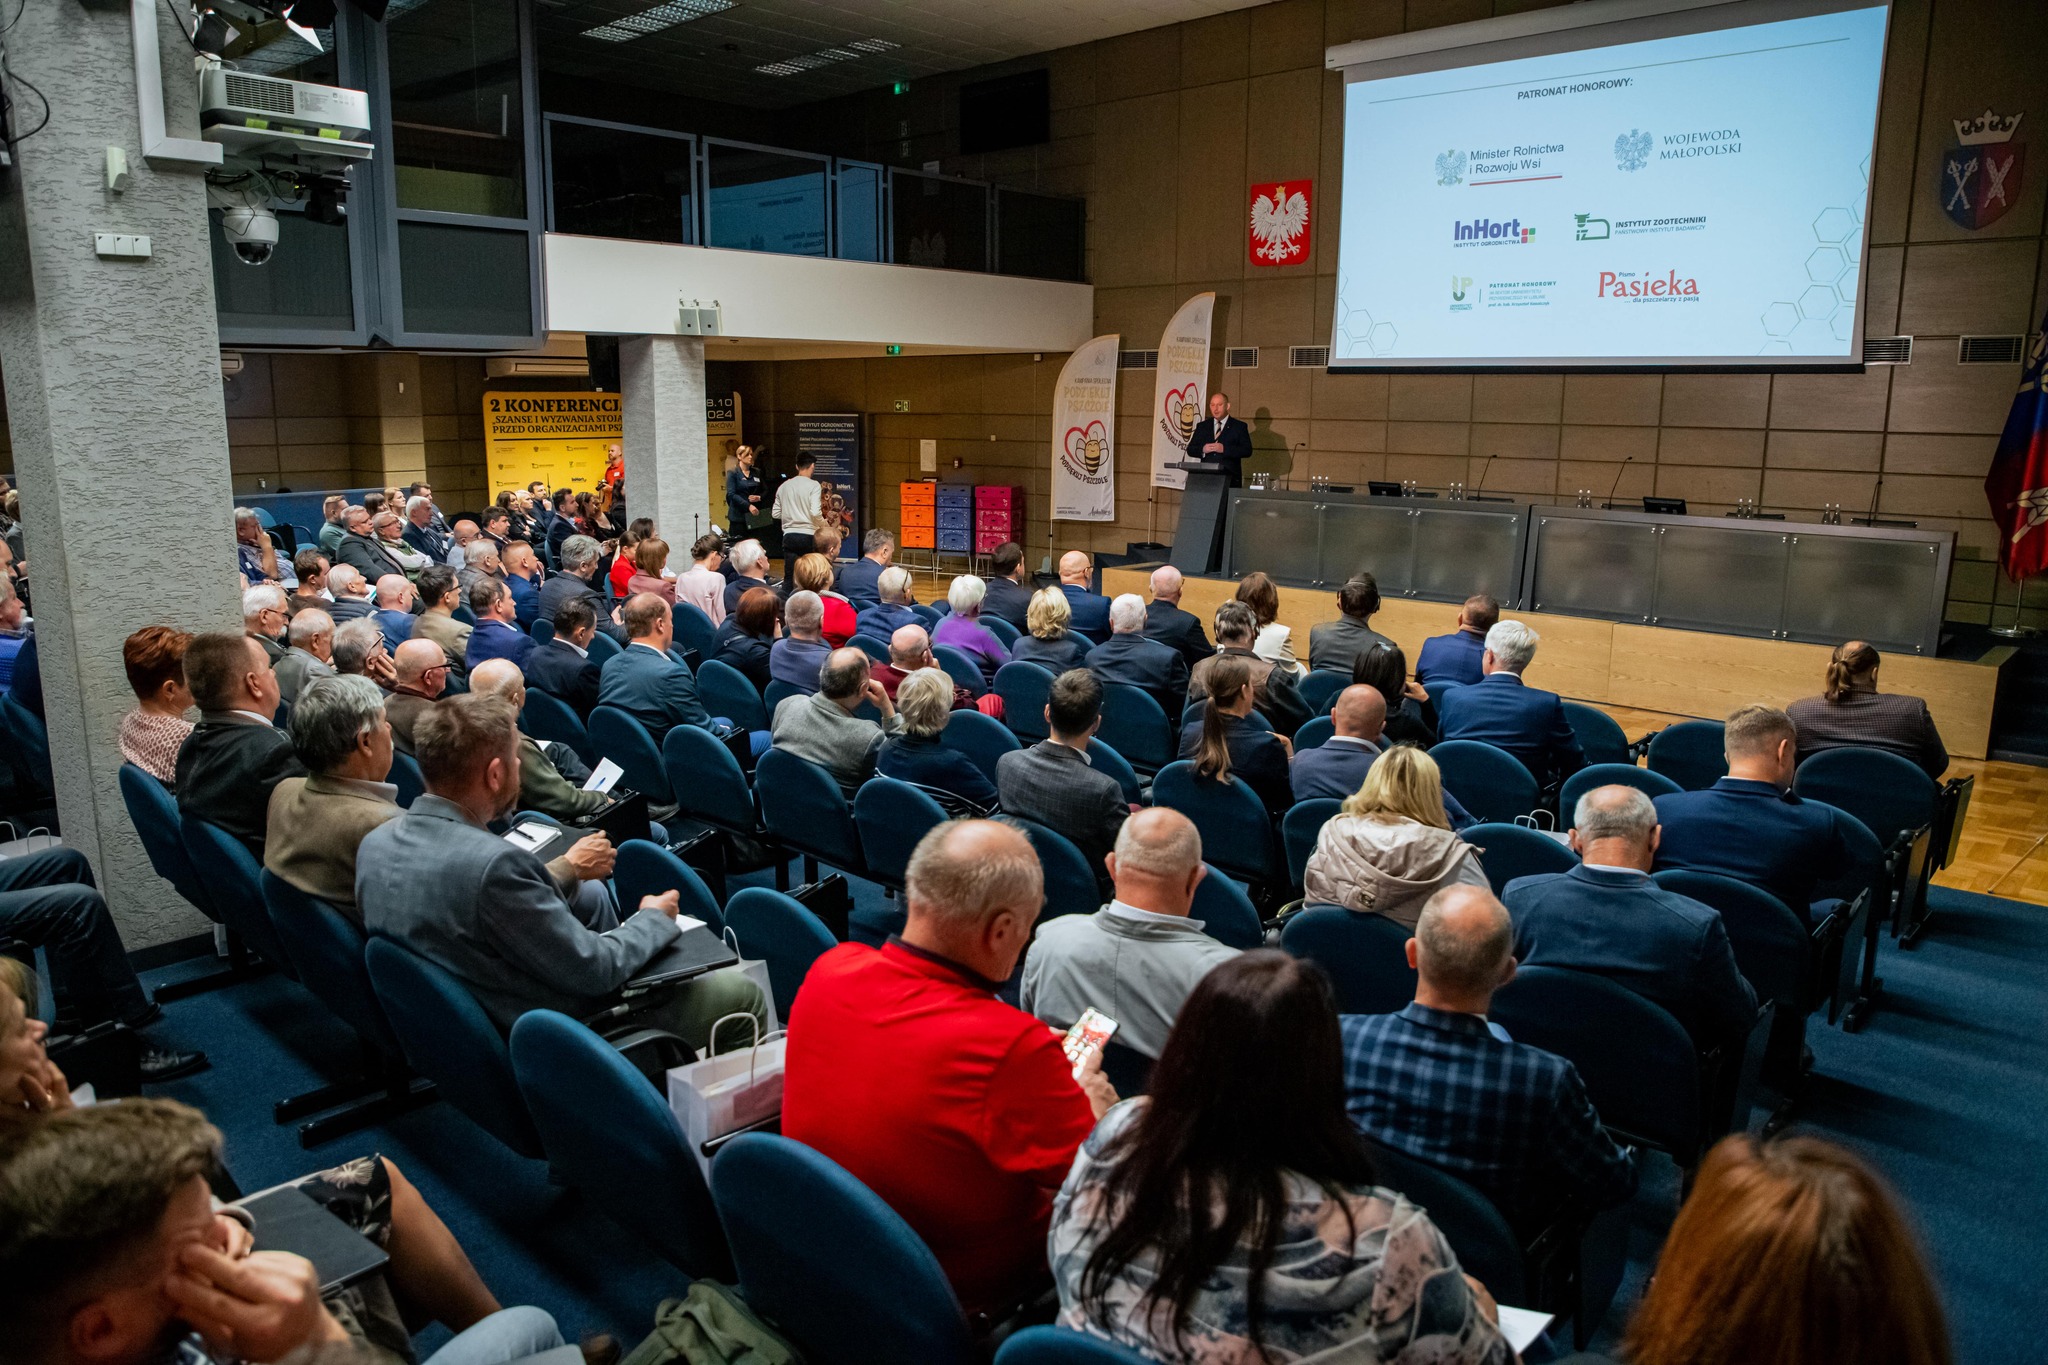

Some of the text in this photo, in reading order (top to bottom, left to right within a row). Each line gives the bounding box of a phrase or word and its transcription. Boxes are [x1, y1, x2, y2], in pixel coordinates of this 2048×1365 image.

[1517, 77, 1633, 100] PATRONAT HONOROWY:
[1663, 129, 1741, 146] WOJEWODA
[1470, 143, 1565, 161] Minister Rolnictwa
[1659, 143, 1742, 160] MAŁOPOLSKI
[1475, 160, 1518, 175] Rozwoju
[1520, 158, 1541, 170] Wsi
[1454, 218, 1520, 241] InHort
[1615, 216, 1707, 228] INSTYTUT ZOOTECHNIKI
[1675, 224, 1706, 232] BADAWCZY
[1480, 239, 1520, 247] OGRODNICTWA
[1597, 269, 1700, 298] Pasieka
[1642, 296, 1677, 304] pszczelarzy
[490, 398, 622, 413] 2 KONFERENCJ
[535, 415, 539, 423] I
[541, 414, 594, 423] WYZWANIA
[492, 425, 525, 434] PRZED
[527, 424, 606, 433] ORGANIZACJAMI
[1083, 474, 1109, 485] PSZCZOLE
